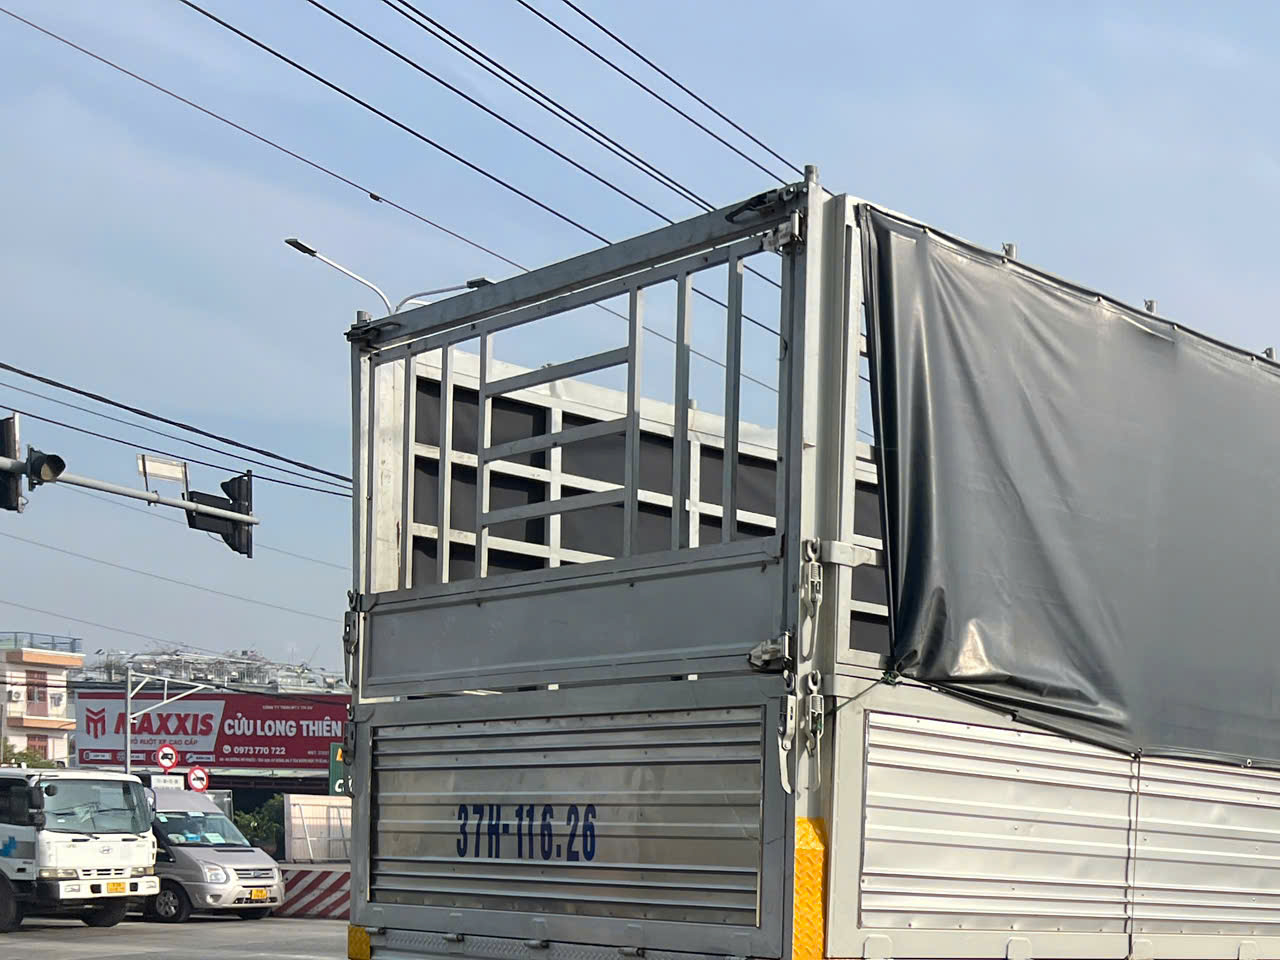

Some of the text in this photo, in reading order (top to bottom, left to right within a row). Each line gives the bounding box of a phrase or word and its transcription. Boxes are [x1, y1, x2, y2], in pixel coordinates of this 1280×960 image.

[114, 712, 213, 736] MAXXIS
[224, 712, 342, 737] CỬU LONG THIÊN
[233, 746, 286, 755] 0973 770 722
[456, 803, 597, 861] 37H-116.26
